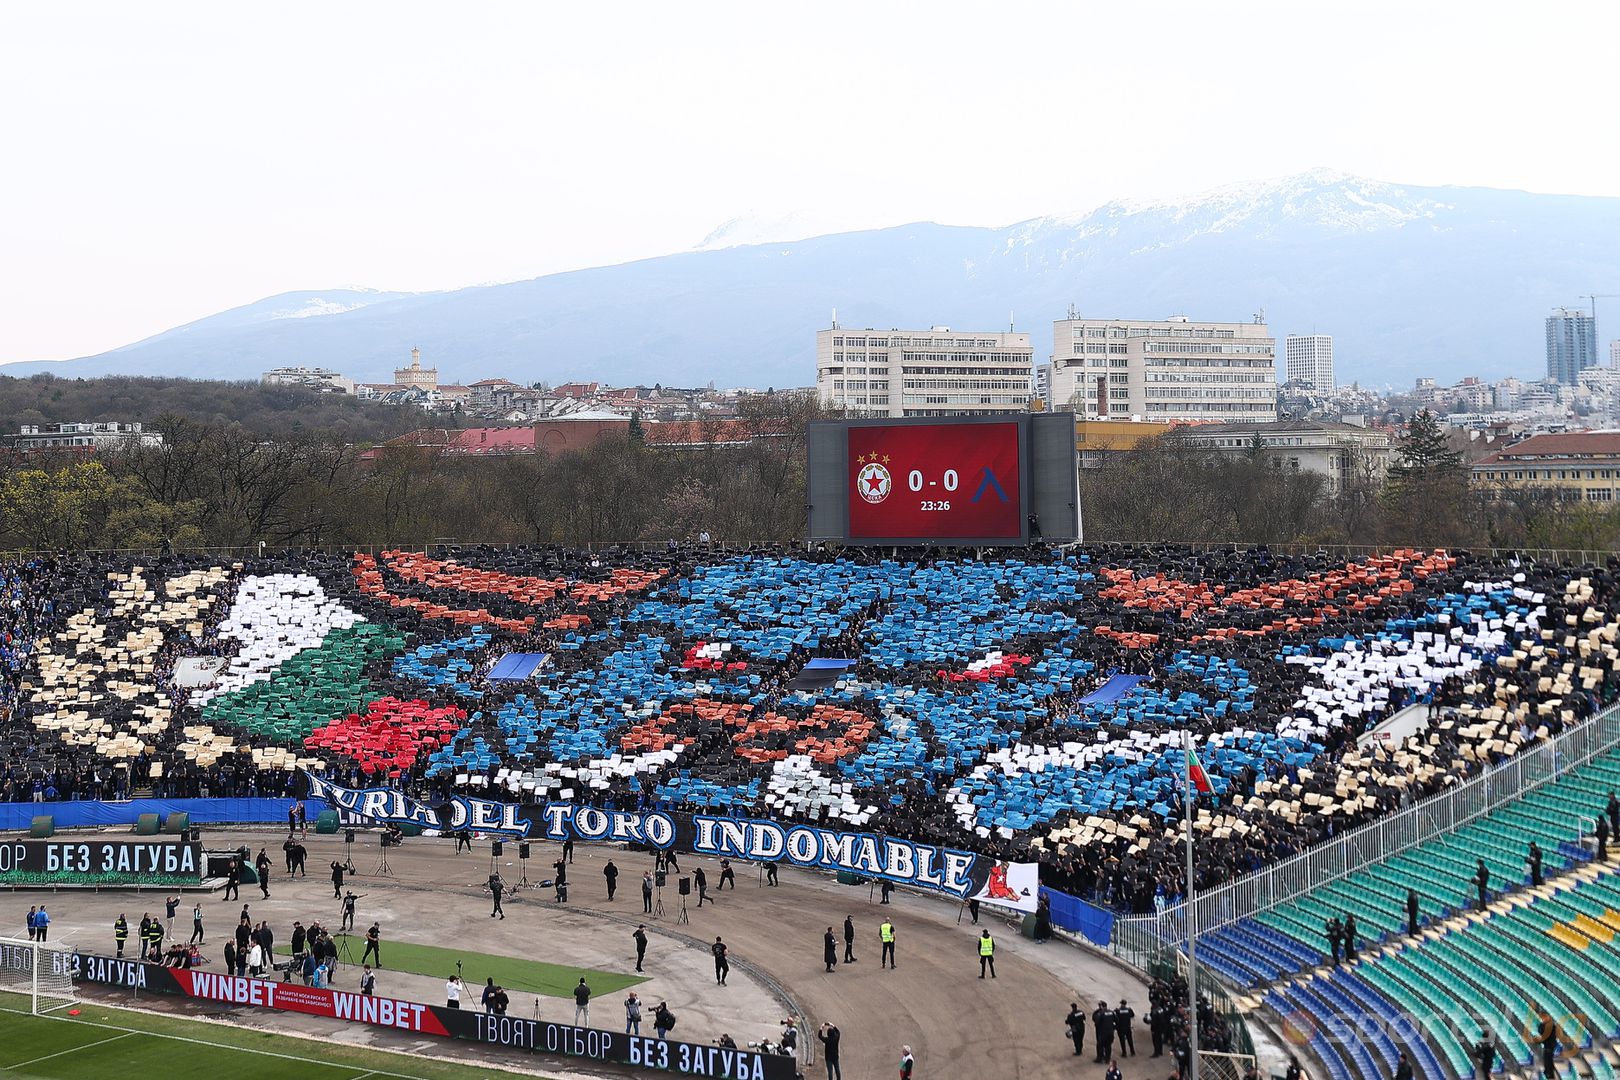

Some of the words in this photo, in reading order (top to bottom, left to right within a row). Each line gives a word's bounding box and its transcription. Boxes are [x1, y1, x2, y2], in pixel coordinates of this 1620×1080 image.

[908, 469, 923, 492] 0
[943, 469, 959, 492] 0
[920, 500, 951, 511] 23:26
[47, 844, 90, 872] БЕЗ
[101, 844, 195, 872] ЗАГУБА
[547, 804, 674, 846] TORO
[695, 817, 976, 896] INDOMABLE
[87, 956, 147, 988] ЗАГУБА
[191, 971, 278, 1007] WINBET
[333, 991, 426, 1031] WINBET
[474, 1013, 537, 1049] ТВОЯТ
[547, 1023, 613, 1060] ОТБОР
[629, 1036, 669, 1069] БЕЗ
[679, 1043, 765, 1080] ЗАГУБА
